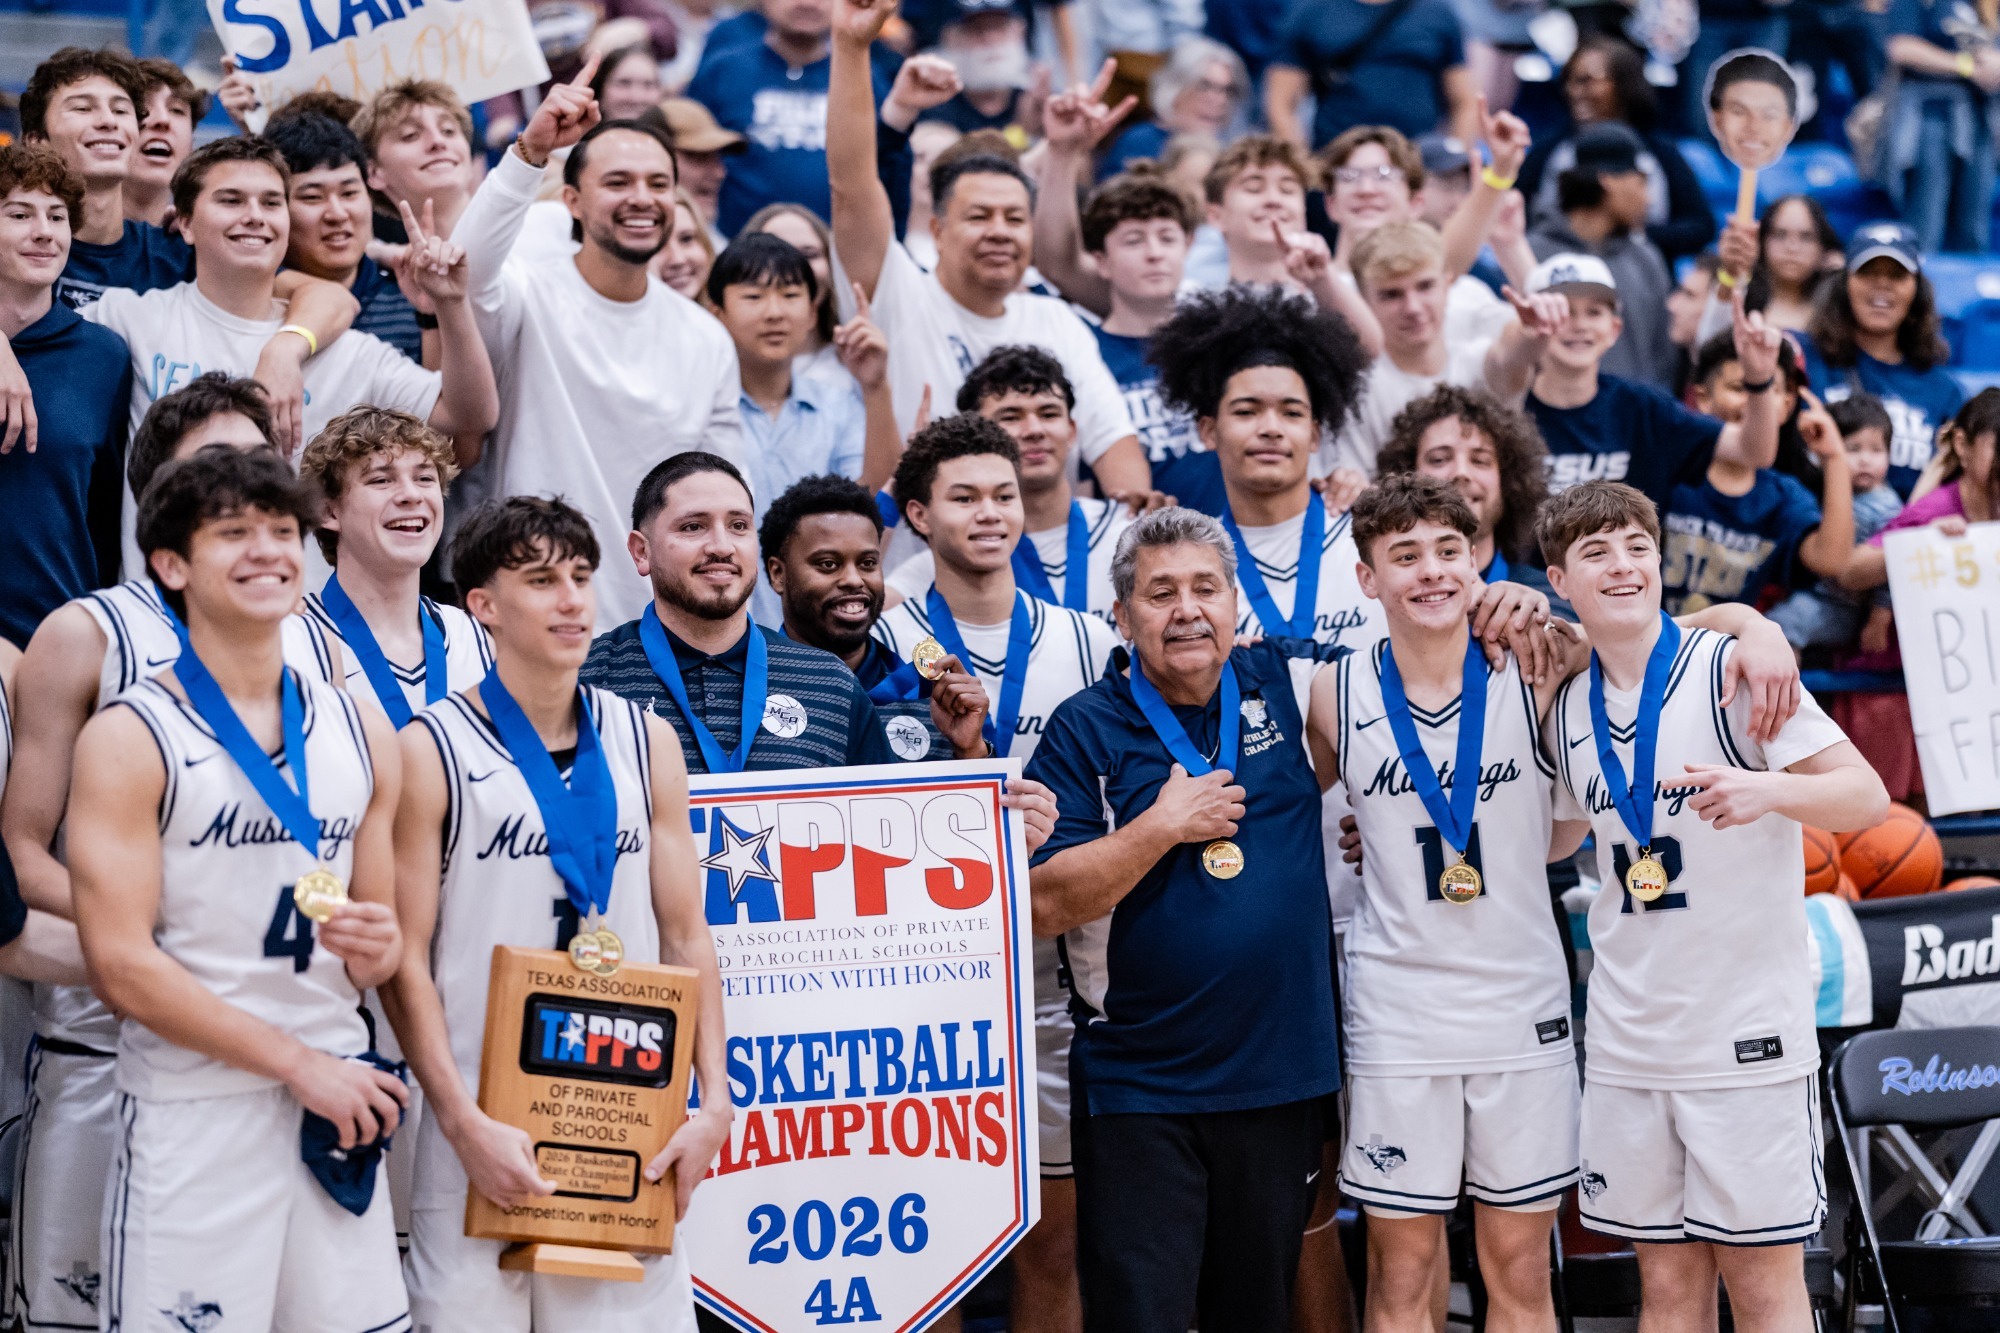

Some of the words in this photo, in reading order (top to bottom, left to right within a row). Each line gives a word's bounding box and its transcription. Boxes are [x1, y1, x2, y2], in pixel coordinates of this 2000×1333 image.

[769, 706, 799, 724] MCA
[896, 727, 922, 746] MCA
[689, 793, 994, 926] APPS
[1611, 833, 1691, 917] 12
[263, 886, 315, 974] 4
[734, 926, 866, 948] ASSOCIATION
[873, 922, 898, 937] OF
[907, 917, 991, 936] PRIVATE
[742, 947, 864, 967] PAROCHIAL
[872, 938, 968, 959] SCHOOLS
[527, 970, 575, 989] TEXAS
[578, 977, 682, 1002] ASSOCIATION
[831, 966, 897, 990] WITH
[904, 959, 993, 984] HONOR
[539, 1009, 664, 1071] TAPPS
[1768, 1043, 1777, 1053] M
[687, 1020, 1005, 1108] SKETBALL
[550, 1084, 571, 1100] OF
[574, 1086, 637, 1107] PRIVATE
[529, 1101, 563, 1117] AND
[566, 1106, 653, 1127] PAROCHIAL
[552, 1121, 628, 1143] SCHOOLS
[575, 1153, 628, 1169] Basketball
[1363, 1143, 1398, 1168] MCA
[541, 1163, 568, 1177] State
[571, 1165, 630, 1184] Champion
[589, 1210, 616, 1225] with
[619, 1214, 659, 1230] Honor
[747, 1193, 929, 1265] 2026
[804, 1276, 882, 1326] 4A
